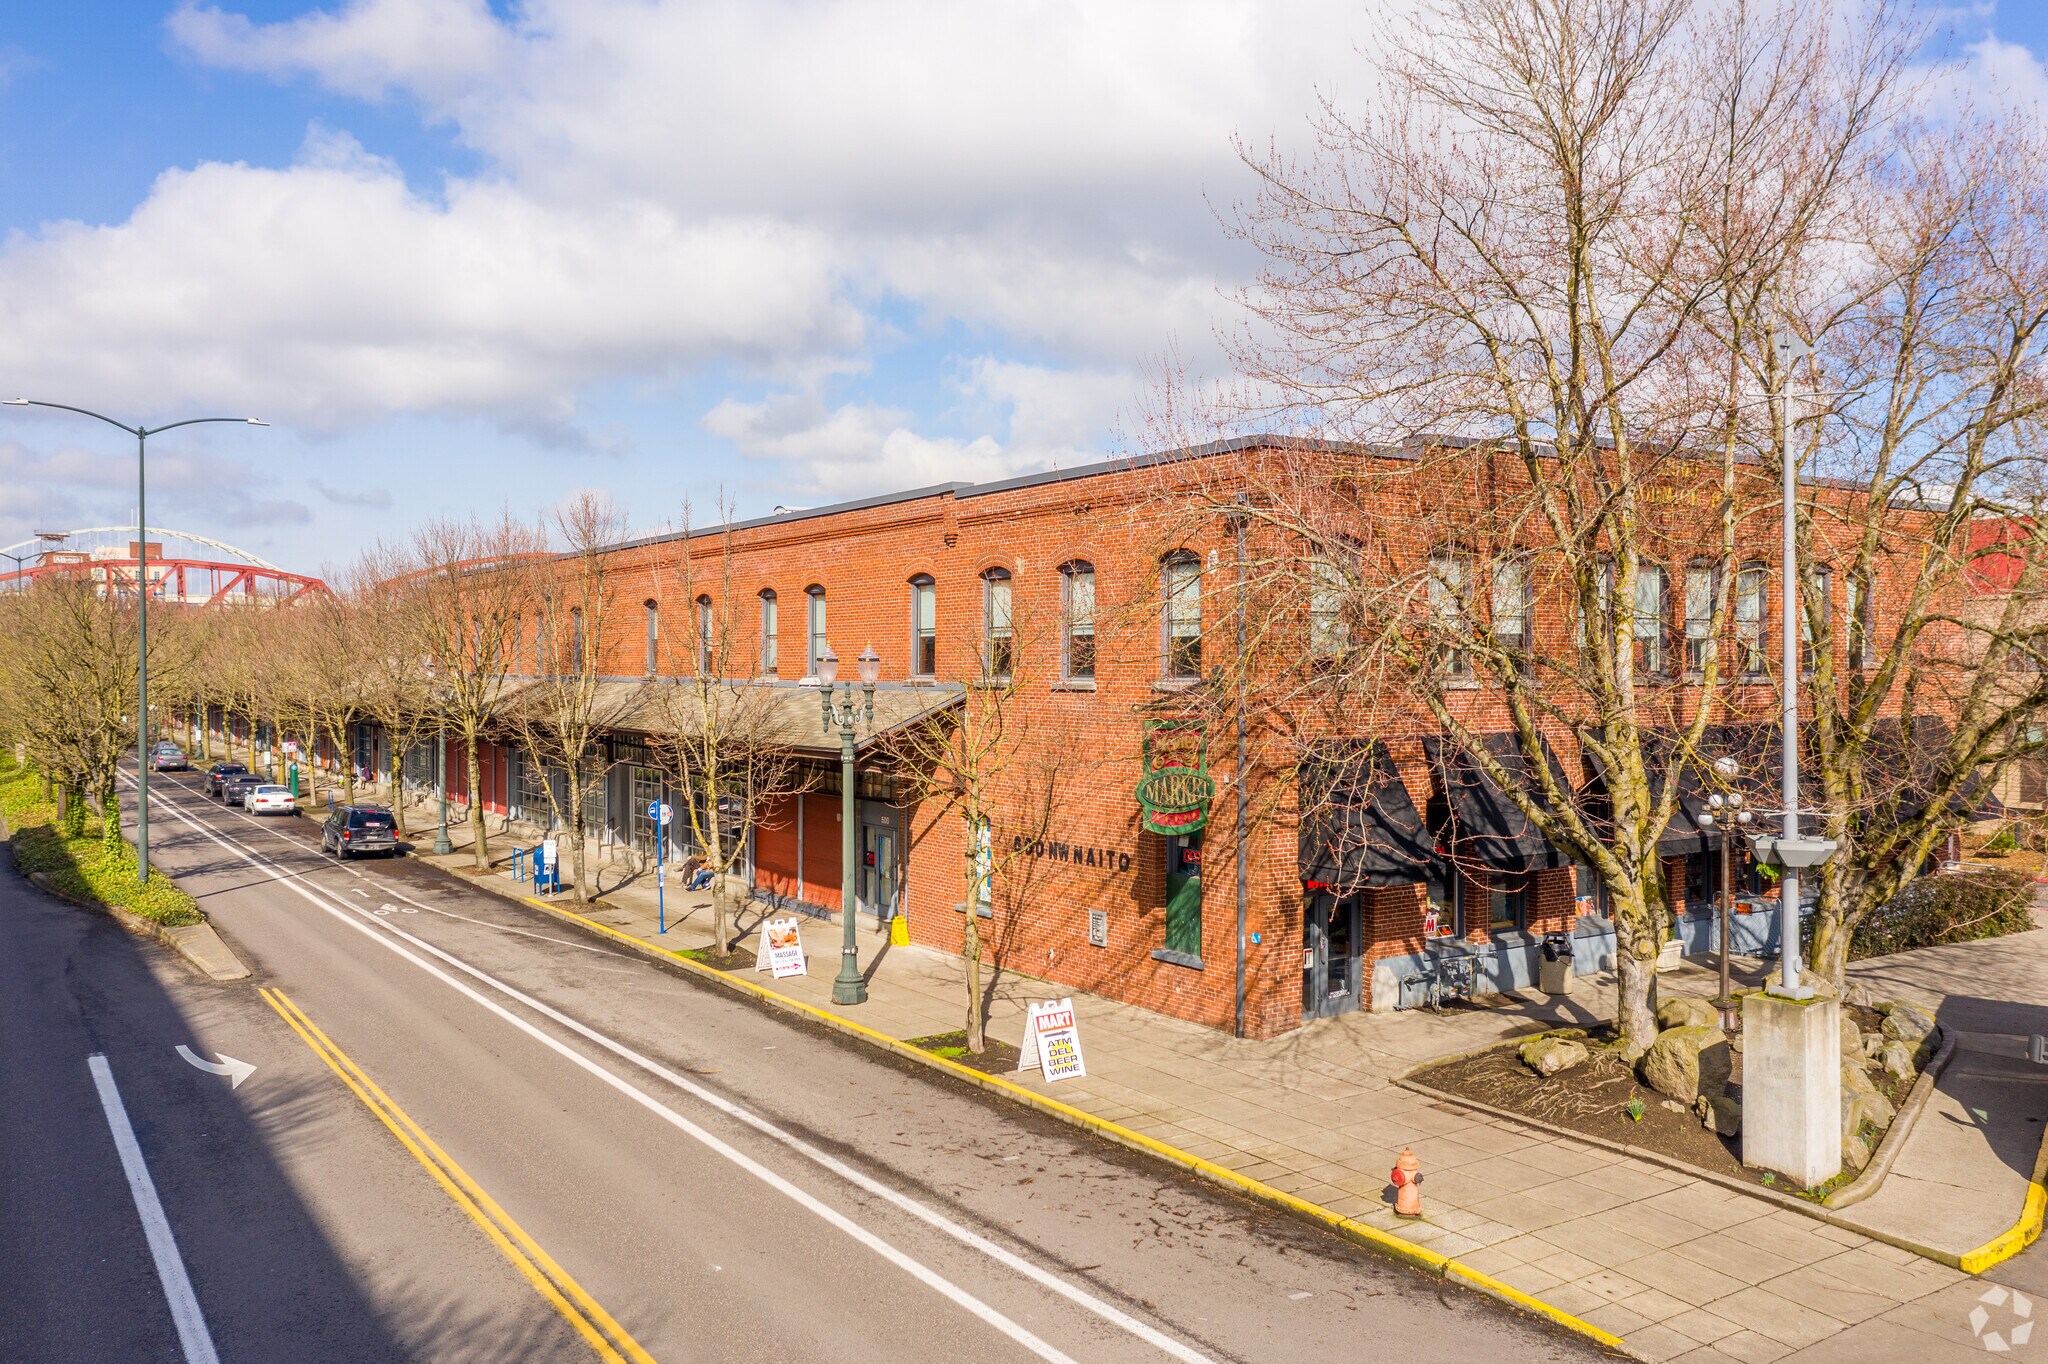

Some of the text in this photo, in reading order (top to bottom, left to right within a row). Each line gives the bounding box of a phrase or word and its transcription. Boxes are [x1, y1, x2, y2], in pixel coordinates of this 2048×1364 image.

[1146, 774, 1210, 806] MARKET
[1048, 841, 1070, 862] NW
[1073, 845, 1130, 873] NAITO
[1183, 849, 1202, 864] OPE
[774, 950, 798, 958] MASSAGE
[1038, 1012, 1071, 1030] MART
[1048, 1037, 1072, 1048] ATM
[1048, 1045, 1074, 1057] DELI
[1048, 1053, 1078, 1067] BEER
[1049, 1063, 1080, 1075] WINE
